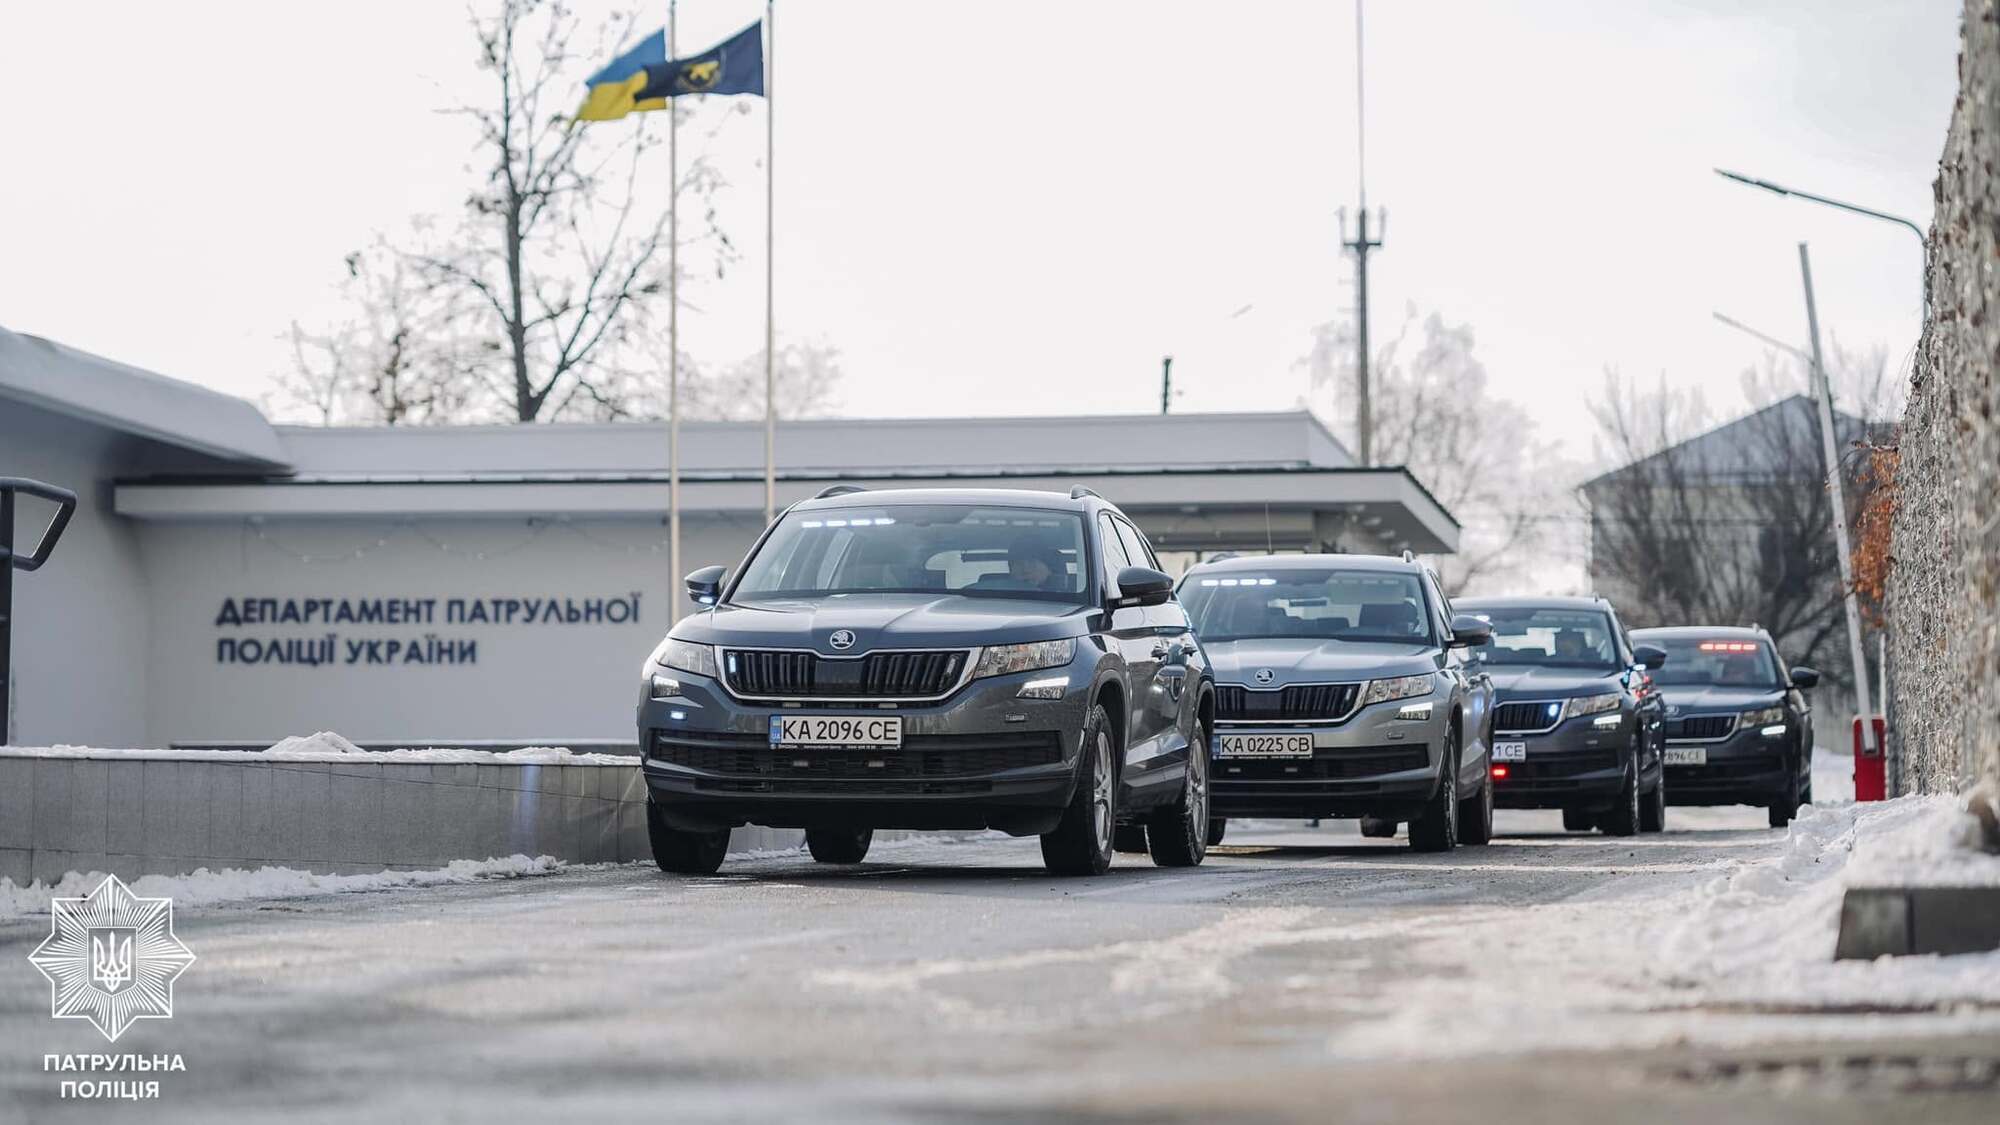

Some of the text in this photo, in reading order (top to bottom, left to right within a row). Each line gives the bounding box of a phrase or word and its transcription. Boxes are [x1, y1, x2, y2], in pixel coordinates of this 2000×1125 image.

[215, 592, 642, 626] ДЕПАРТАМЕНТ ПАТРУЛЬНОЇ
[216, 634, 477, 667] ПОЛІЦІЇ УКРАЇНИ
[816, 720, 864, 740] 2096
[1247, 737, 1284, 752] 0225
